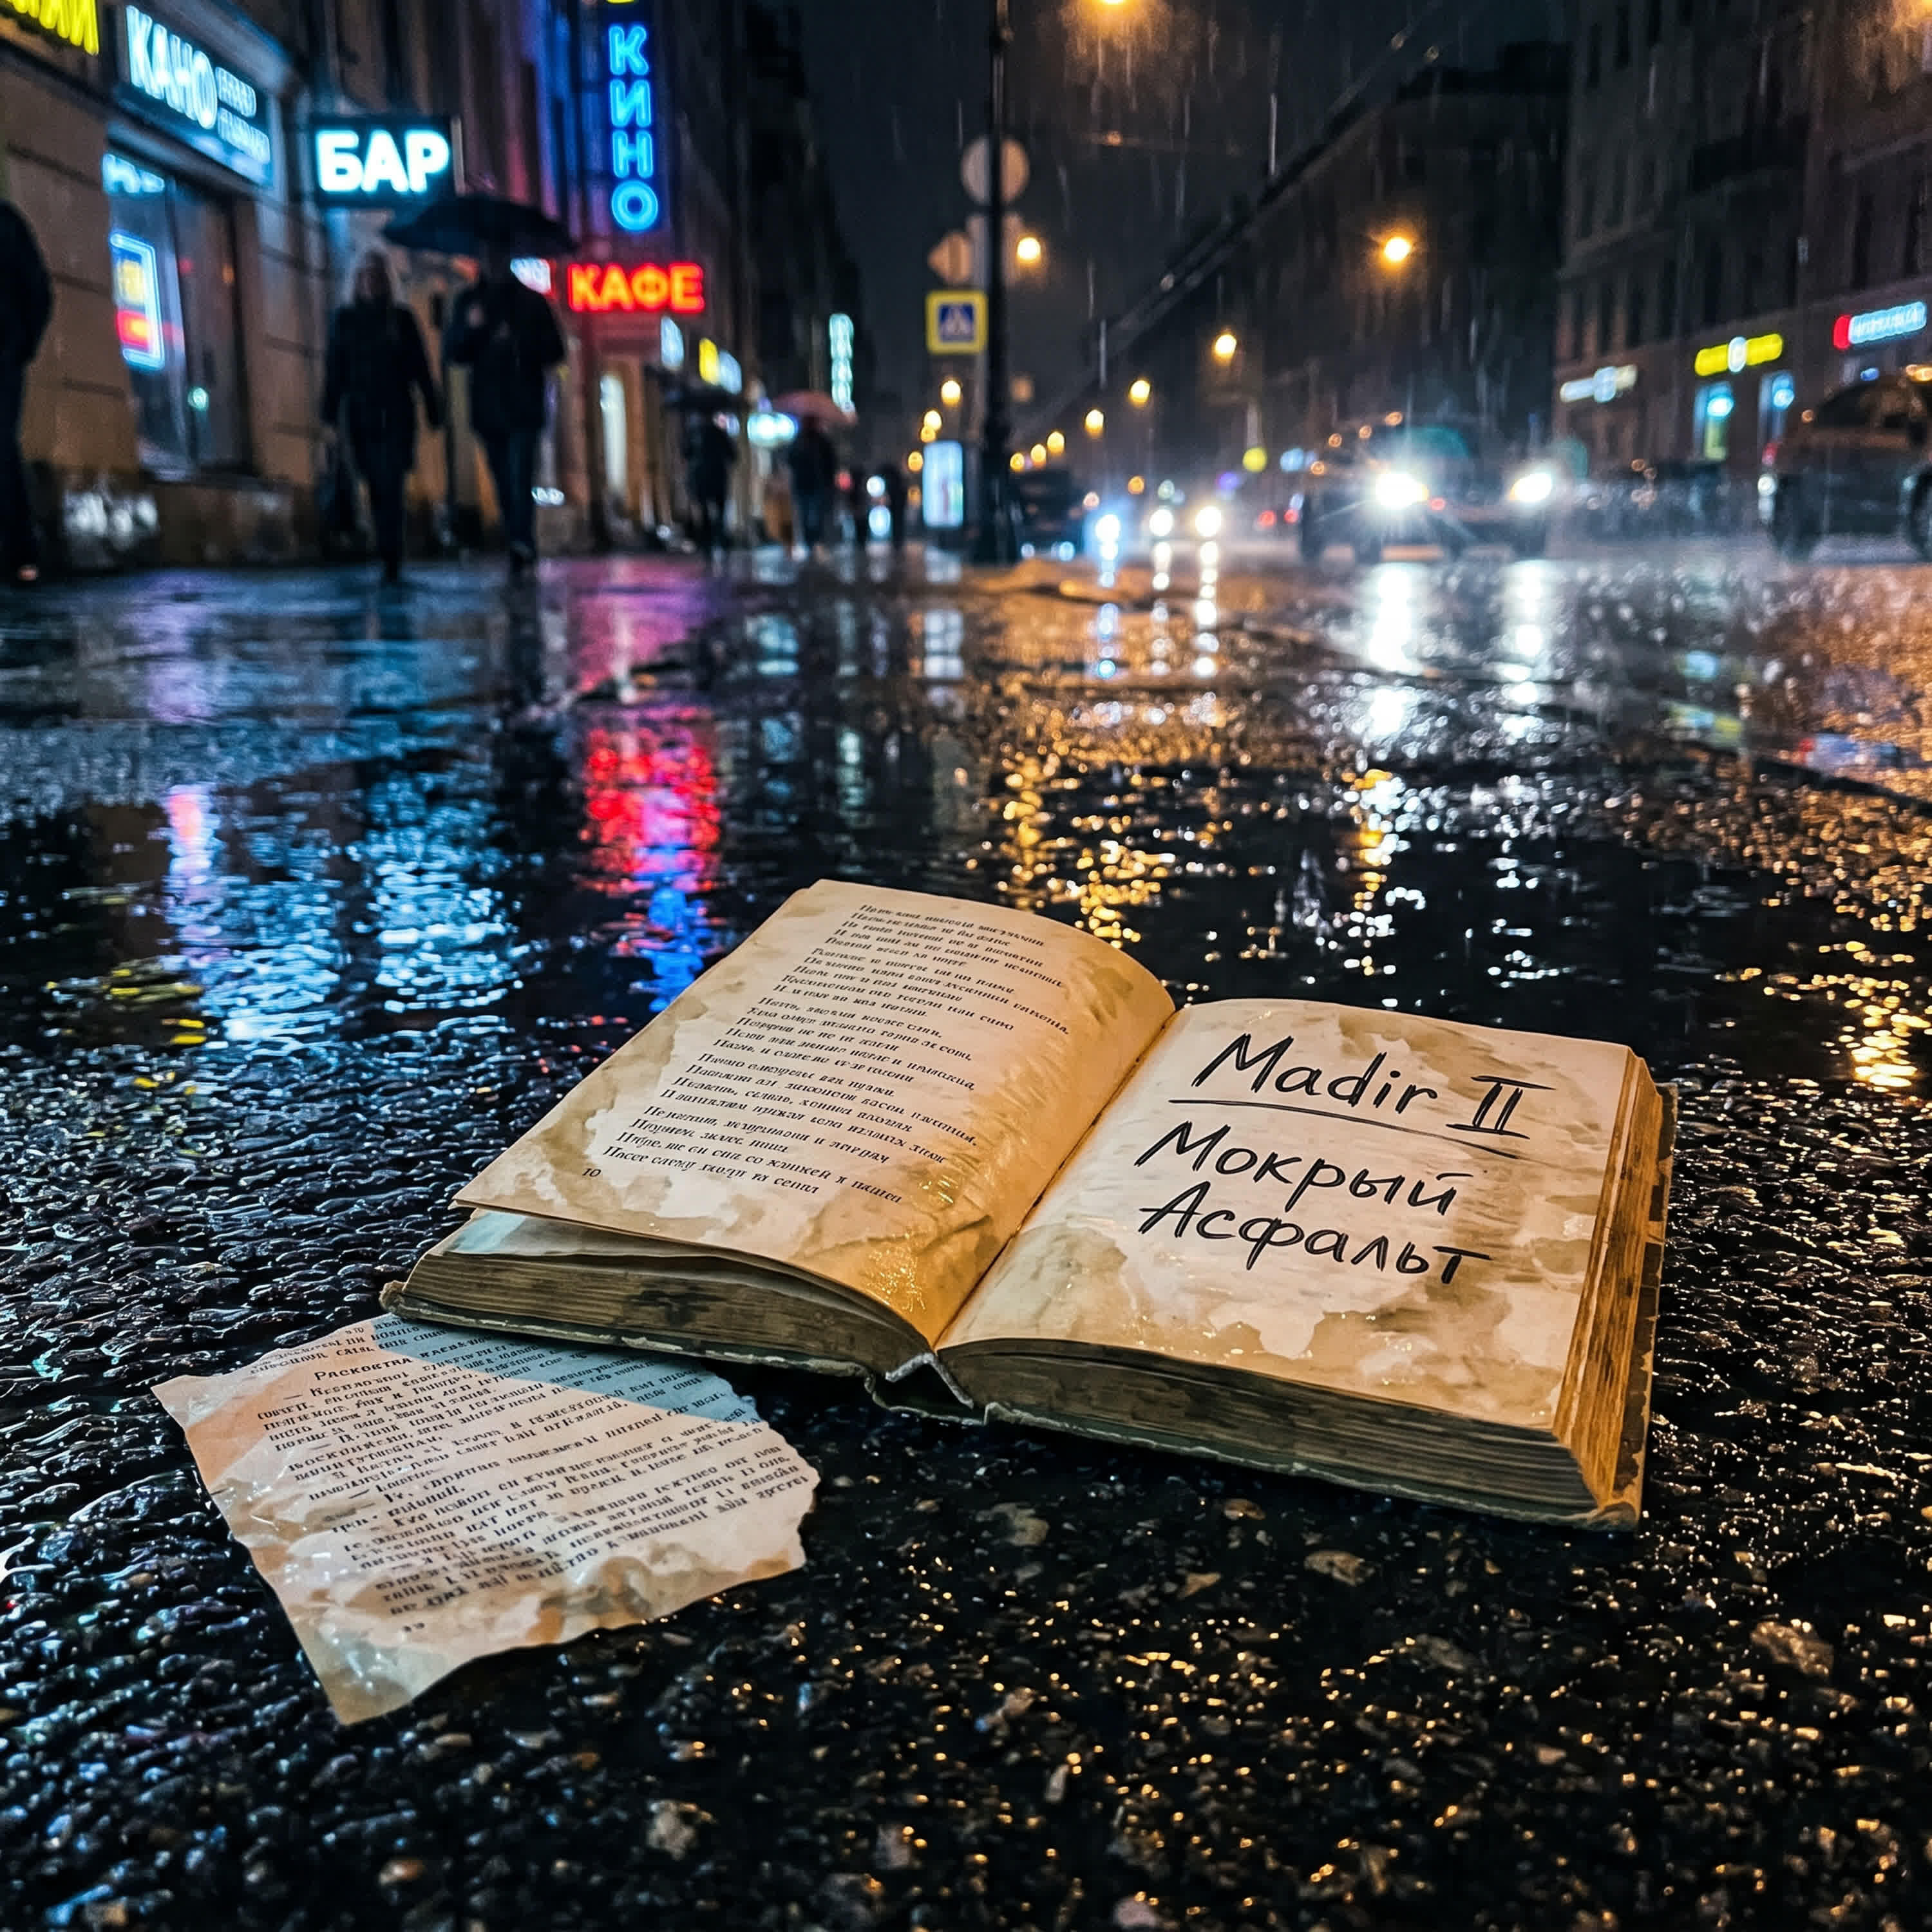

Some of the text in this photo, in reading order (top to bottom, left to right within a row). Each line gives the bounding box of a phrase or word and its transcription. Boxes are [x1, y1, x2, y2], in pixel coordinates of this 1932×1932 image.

[316, 129, 450, 193] БАР
[607, 25, 659, 232] КИНО
[568, 263, 705, 312] КАФЕ
[1191, 1033, 1556, 1140] Madir II
[1135, 1121, 1474, 1215] Мокрый
[1138, 1181, 1493, 1284] Асфальт
